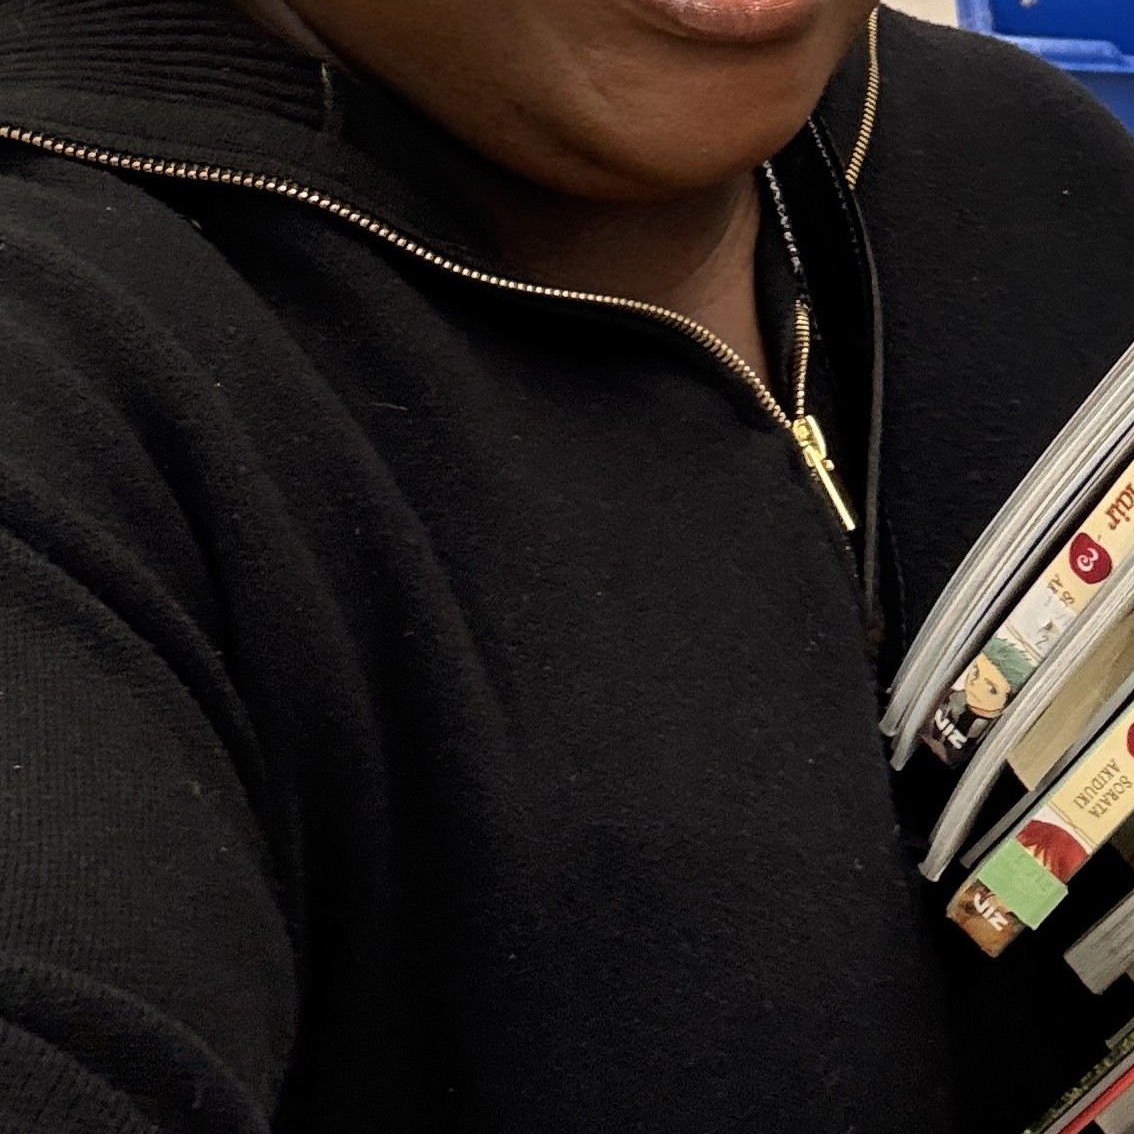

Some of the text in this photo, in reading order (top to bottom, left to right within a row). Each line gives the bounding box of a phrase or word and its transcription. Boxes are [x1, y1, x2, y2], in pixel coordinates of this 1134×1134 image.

[1076, 547, 1099, 573] 3
[933, 708, 968, 750] VIZ
[1072, 757, 1122, 810] AKIDUKI
[1087, 774, 1134, 819] SORATA
[973, 892, 1009, 932] VIZ
